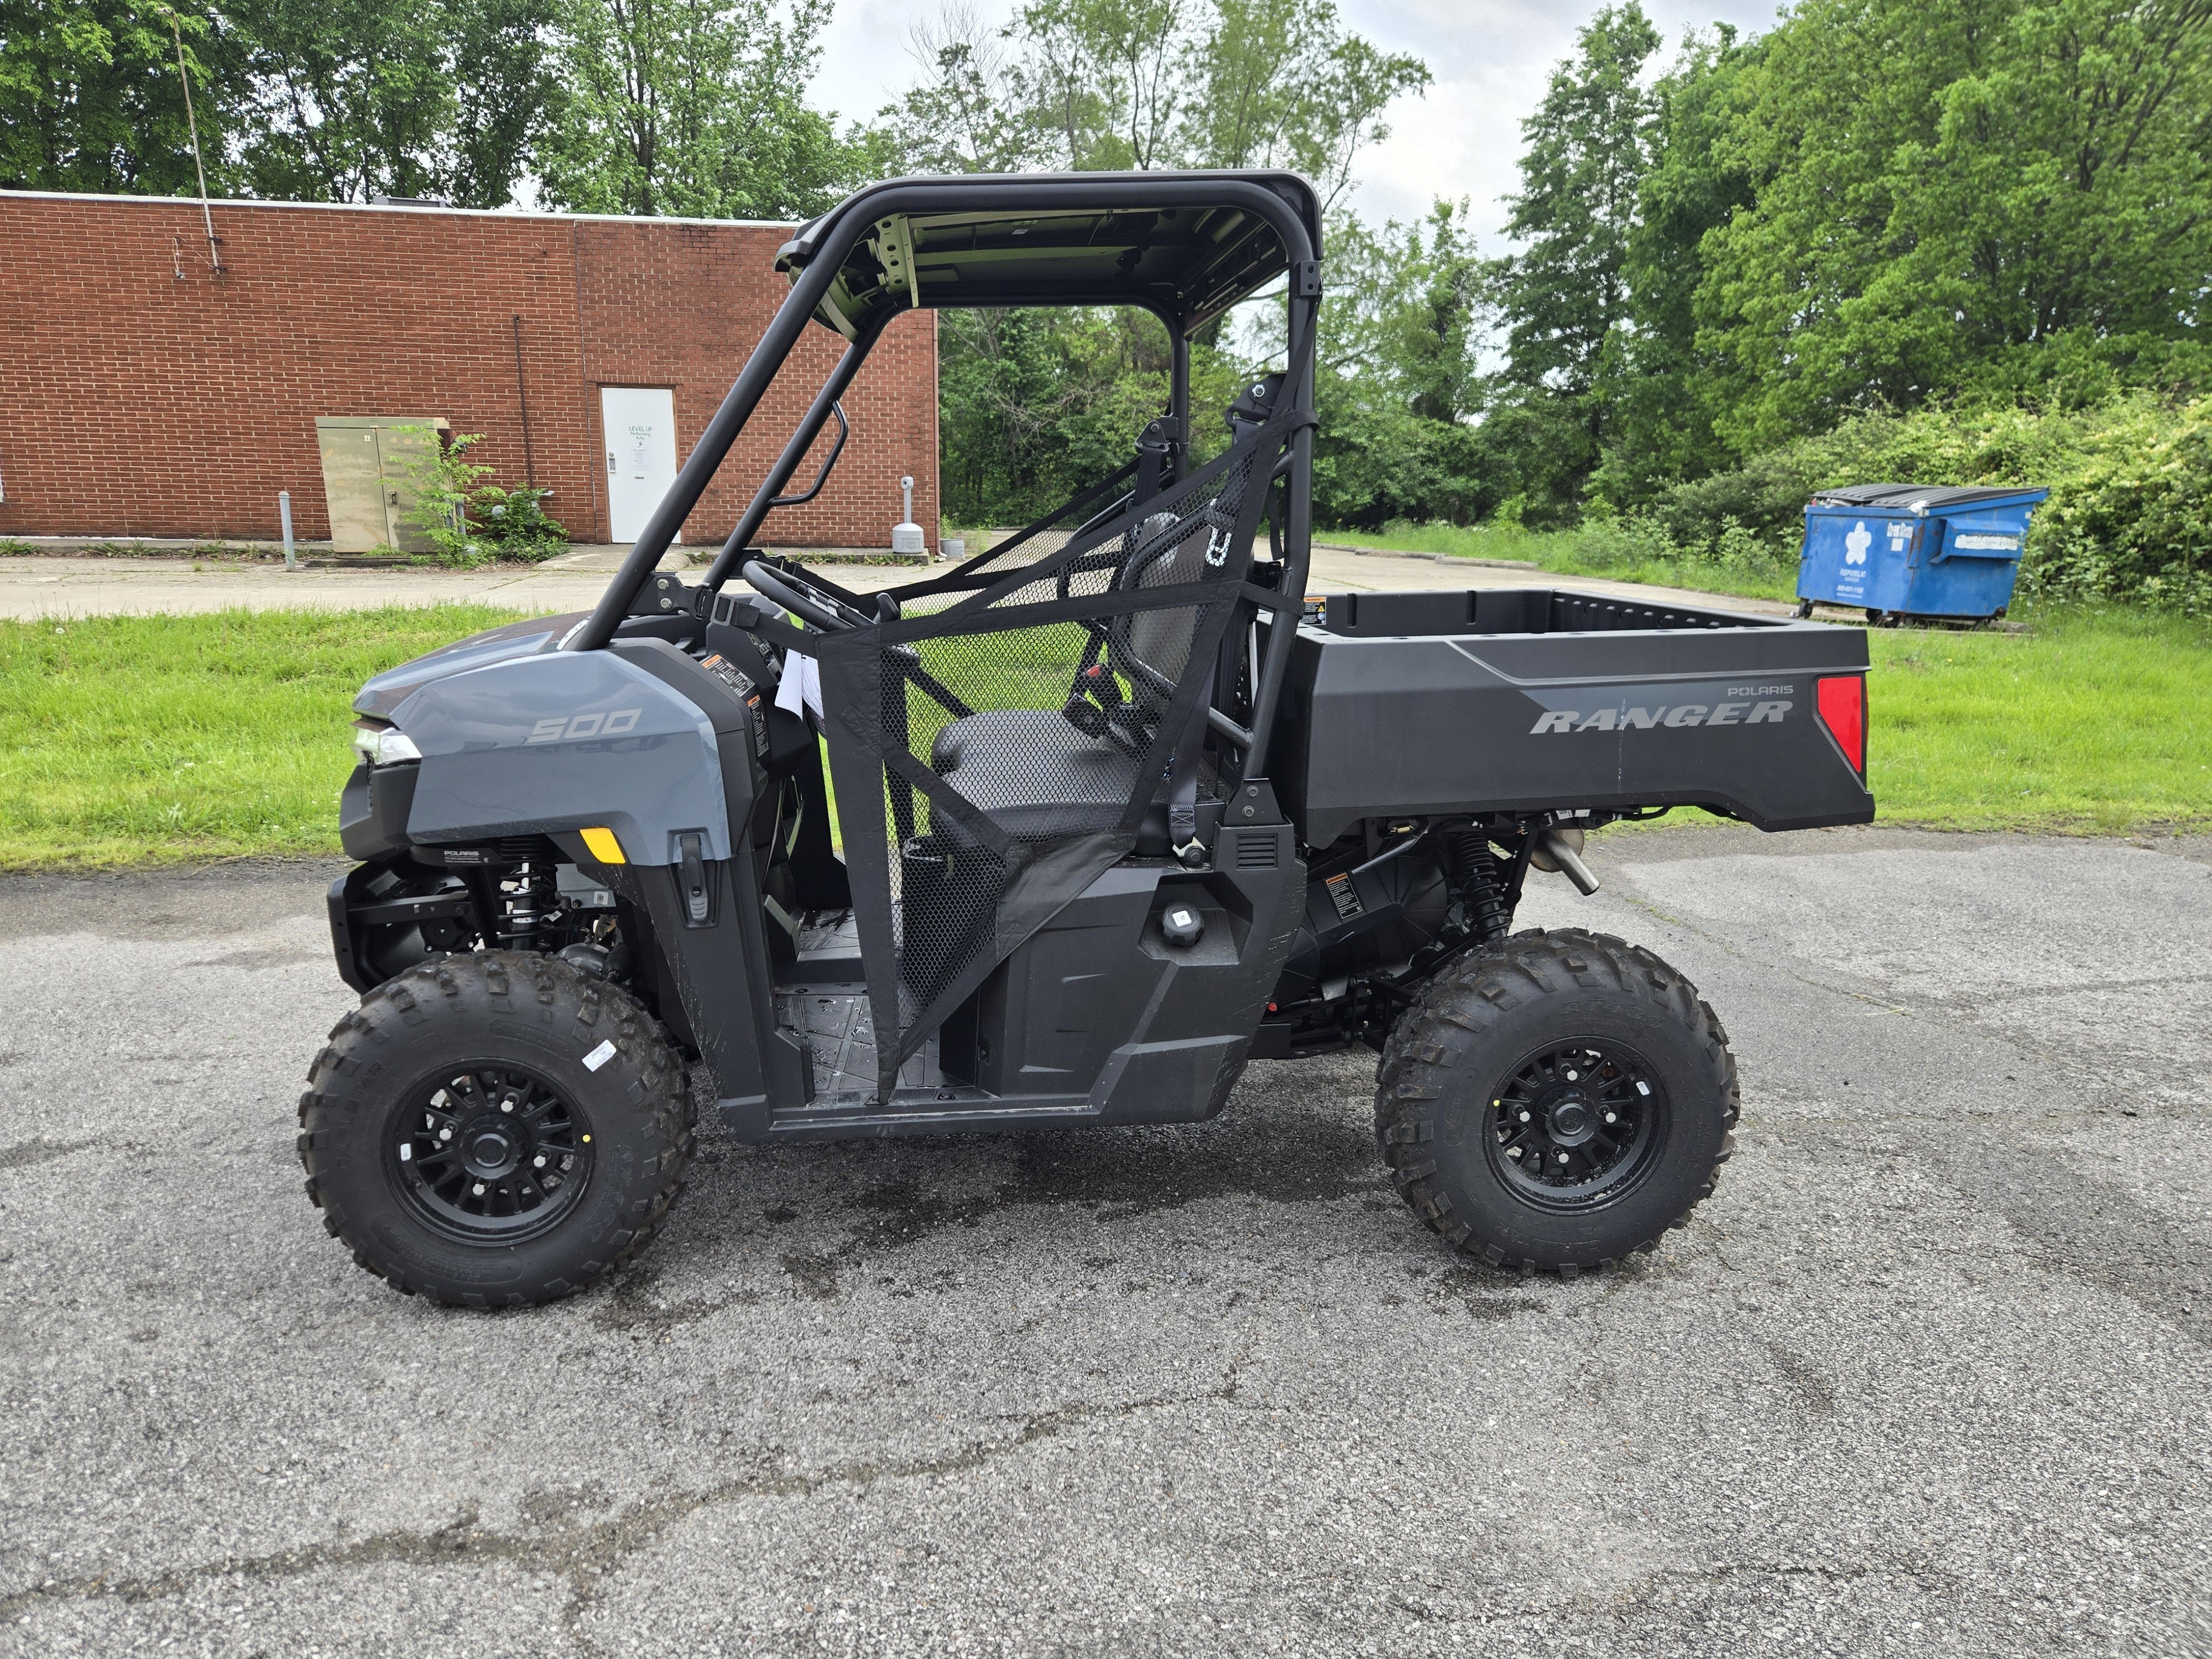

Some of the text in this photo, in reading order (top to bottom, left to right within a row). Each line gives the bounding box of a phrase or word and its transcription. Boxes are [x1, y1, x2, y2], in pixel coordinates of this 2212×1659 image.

[1728, 685, 1794, 697] POLARIS
[527, 708, 643, 744] 500
[1530, 701, 1793, 734] RANGER
